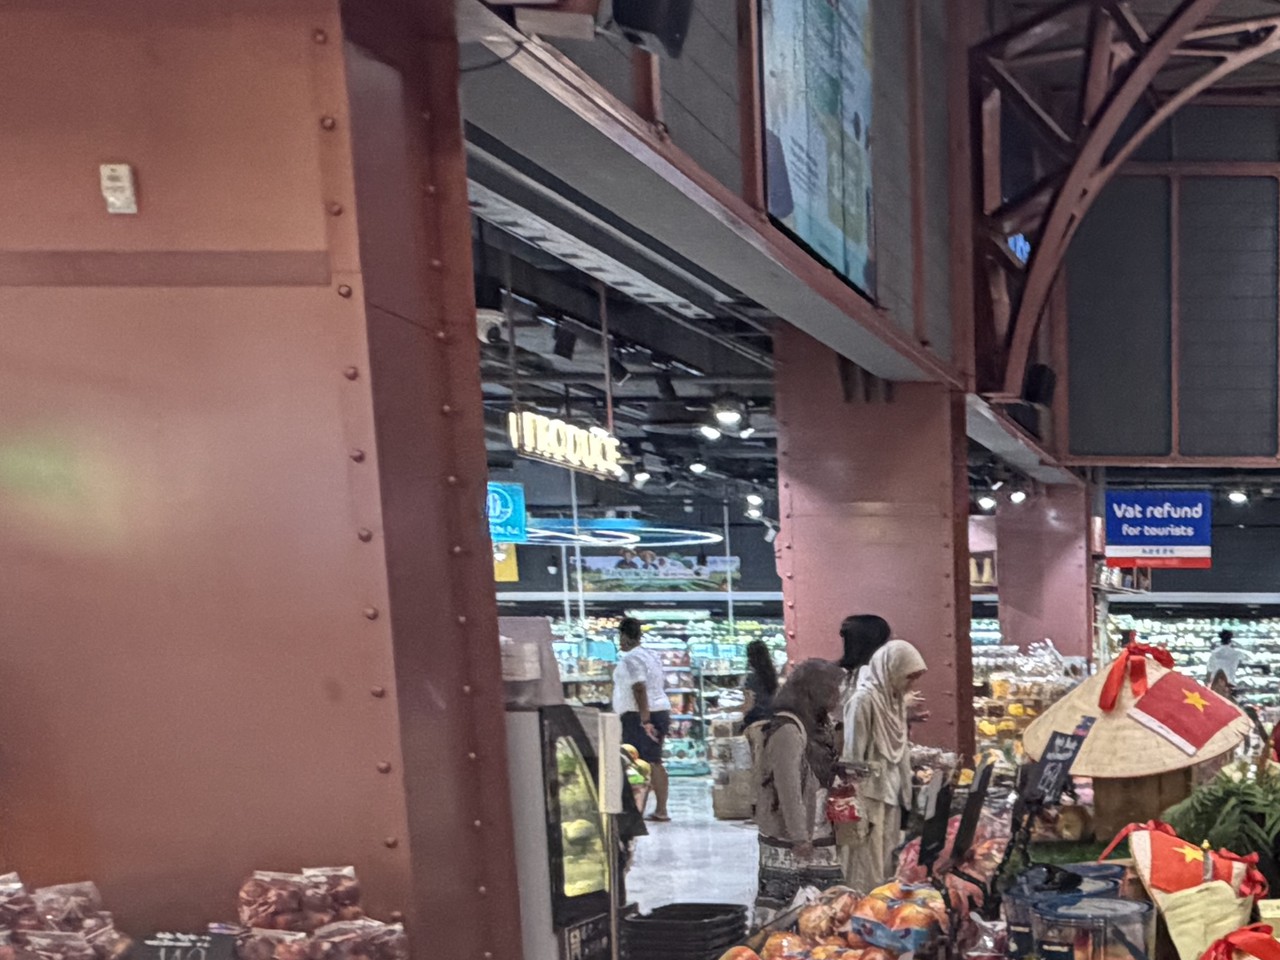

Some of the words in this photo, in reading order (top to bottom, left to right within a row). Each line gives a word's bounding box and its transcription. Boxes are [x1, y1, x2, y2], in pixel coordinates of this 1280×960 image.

[1112, 503, 1143, 518] Vat
[1146, 502, 1203, 519] refund
[1121, 523, 1141, 536] for
[1143, 524, 1194, 536] tourists
